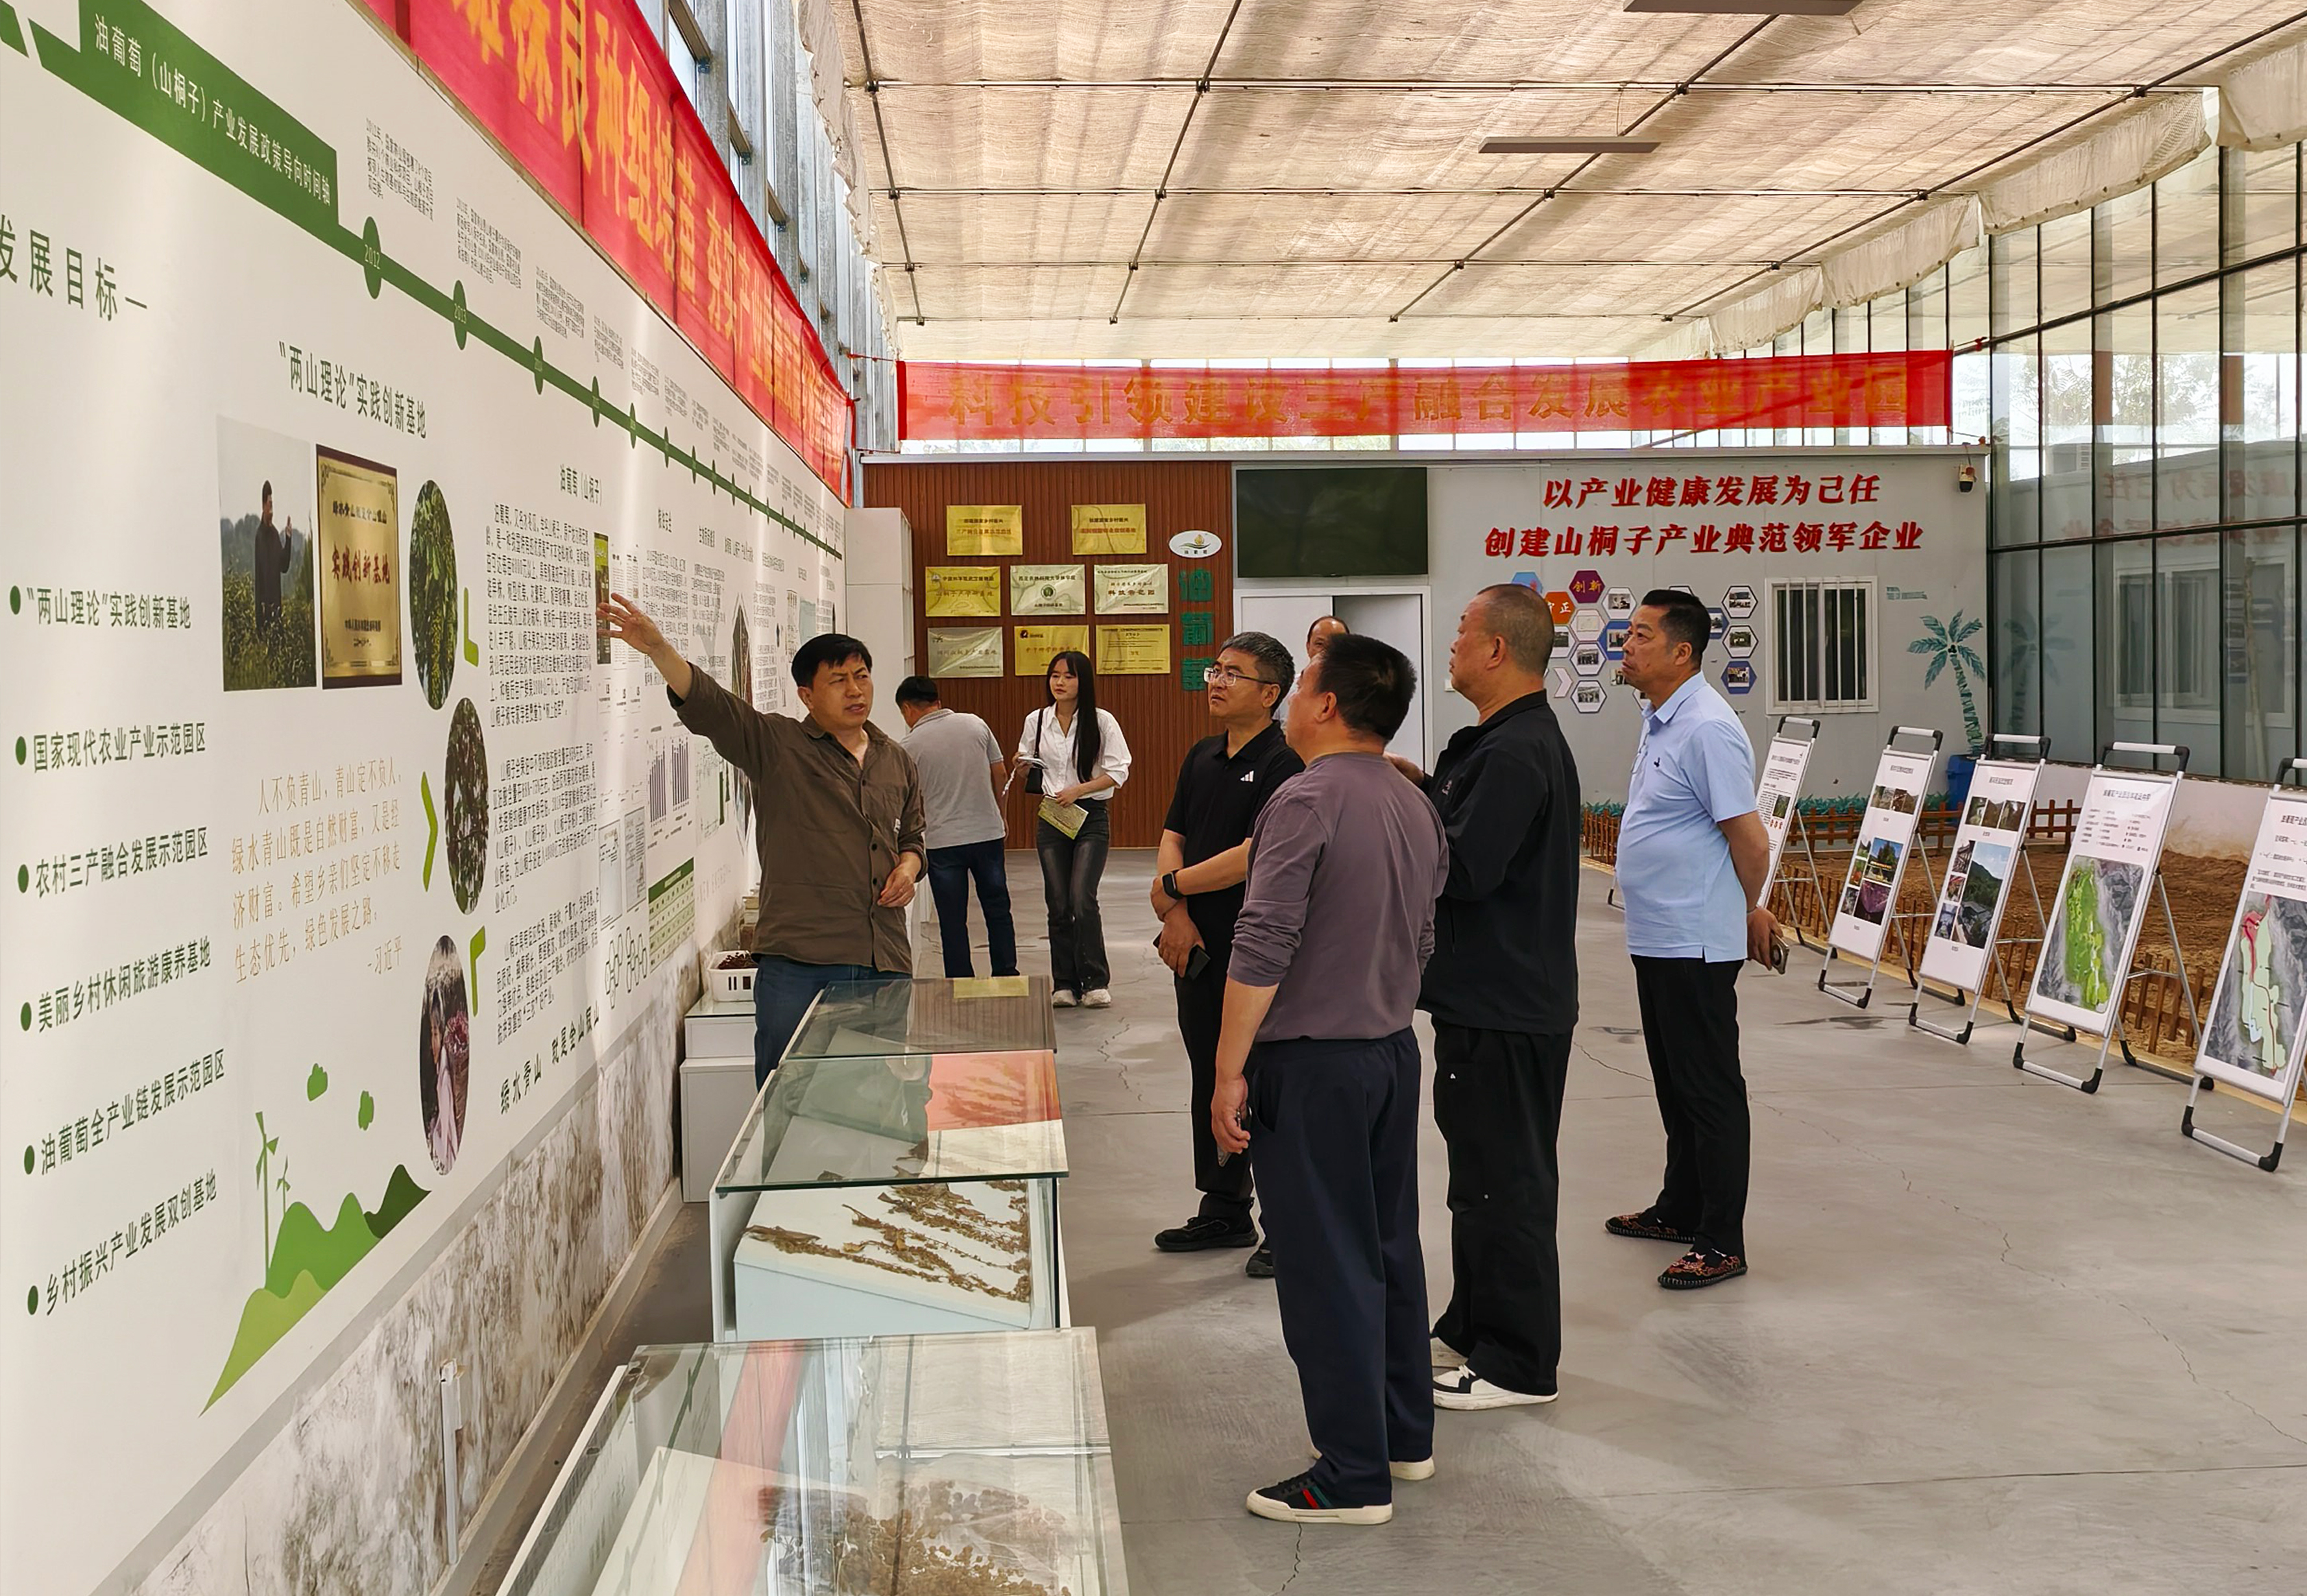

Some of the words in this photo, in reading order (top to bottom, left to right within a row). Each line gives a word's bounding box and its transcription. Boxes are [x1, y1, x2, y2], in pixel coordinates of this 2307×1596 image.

[365, 244, 380, 270] 2012
[1543, 474, 1881, 509] 以产业健康发展为己任
[1484, 521, 1924, 559] 创建山桐子产业典范领军企业
[1573, 579, 1602, 593] 创新
[33, 721, 206, 773] 国家现代农业产业示范园区
[36, 826, 208, 899] 农村三产融合发展示范园区
[38, 935, 211, 1033] 美丽乡村休闲旅游康养基地
[41, 1048, 225, 1176] 油葡萄全产业链发展示范园区
[47, 1168, 217, 1316] 乡村振兴产业发展双创基地
